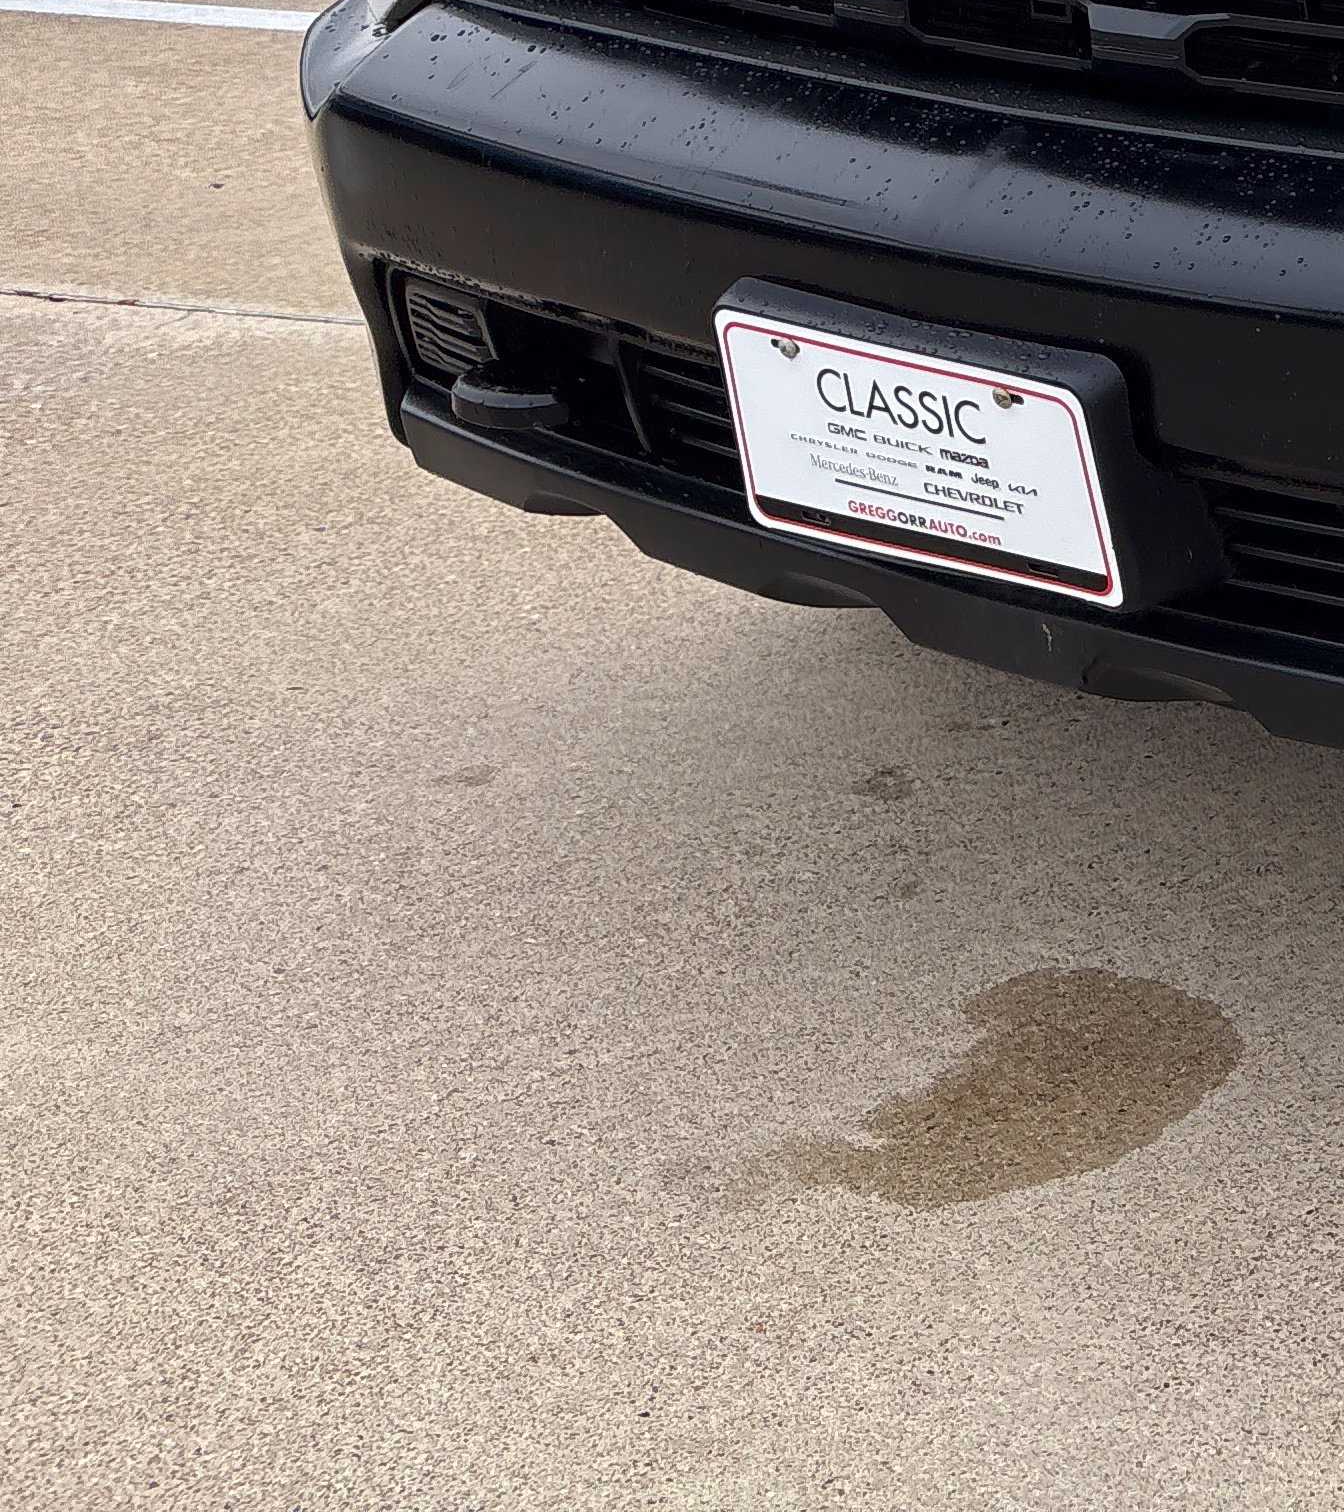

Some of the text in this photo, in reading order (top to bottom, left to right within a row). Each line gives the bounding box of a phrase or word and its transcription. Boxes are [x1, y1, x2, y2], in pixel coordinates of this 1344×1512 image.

[816, 368, 987, 445] CLASSIC
[790, 433, 858, 455] CHRYSLER
[866, 451, 918, 469] DODGE
[925, 464, 963, 479] RAM
[971, 472, 1000, 491] Jeep
[827, 422, 868, 442] GMC
[873, 434, 933, 456] BUICK
[810, 452, 1024, 515] Mercedes-Benz CHEVROLET
[847, 499, 1001, 546] GREGGORRAUTO.com
